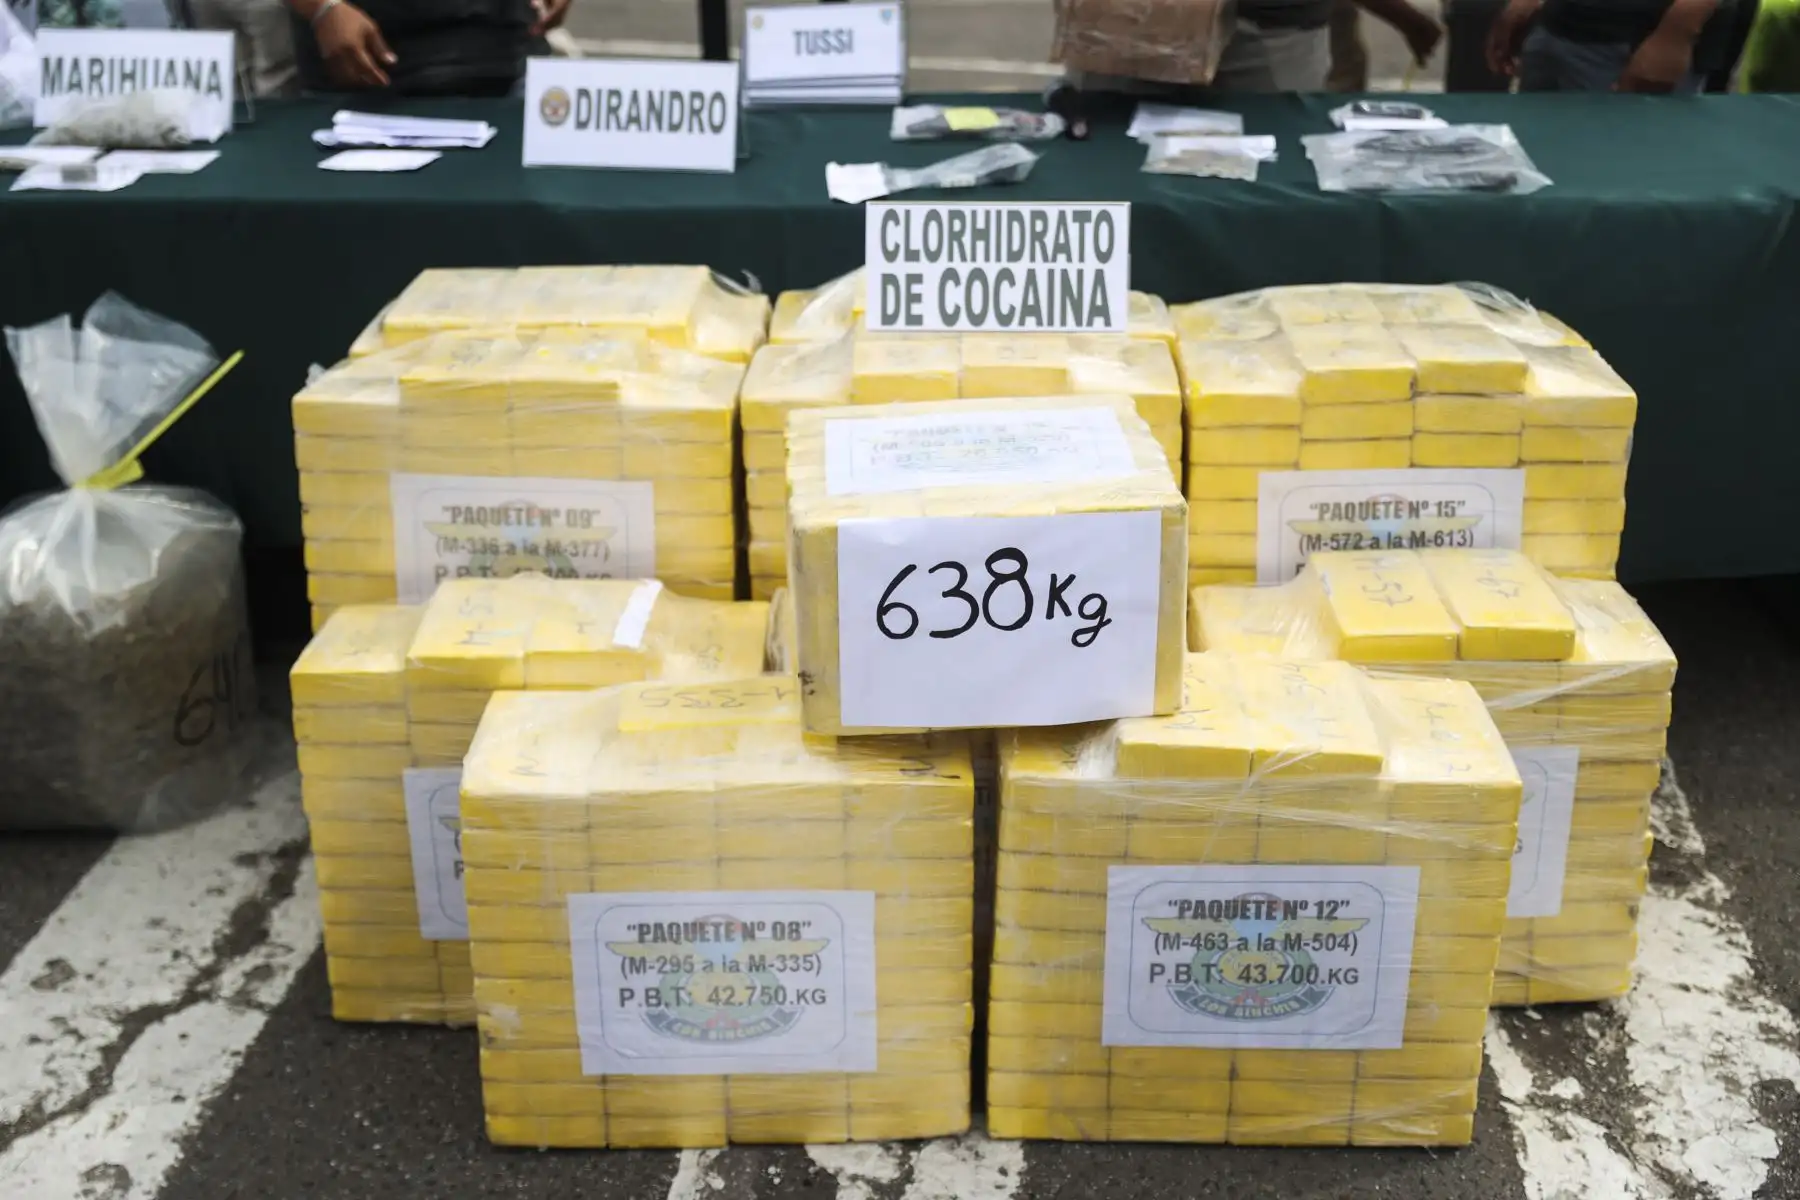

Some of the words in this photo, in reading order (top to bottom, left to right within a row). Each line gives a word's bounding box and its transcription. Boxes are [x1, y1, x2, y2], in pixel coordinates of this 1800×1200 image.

[793, 29, 854, 56] TUSSI
[40, 57, 223, 101] MARIHUANA
[574, 88, 726, 134] DIRANDRO
[880, 208, 1115, 264] CLORHIDRATO
[880, 272, 924, 327] DE
[938, 267, 1112, 327] COCAINA
[503, 542, 517, 556] a
[523, 538, 539, 556] la
[545, 539, 611, 561] M-377)
[1299, 532, 1363, 555] (M-572
[1369, 537, 1381, 549] a
[1387, 532, 1403, 549] la
[1409, 530, 1474, 551] M-613)
[876, 547, 1033, 640] 638
[1045, 573, 1112, 647] Kg
[1154, 932, 1228, 955] (M-463
[1236, 937, 1249, 951] a
[1256, 932, 1275, 951] la
[1283, 932, 1358, 956] M-504)
[620, 955, 695, 979] (M-295
[701, 960, 715, 972] a
[722, 956, 741, 973] la
[748, 953, 822, 977] M-335)
[1150, 963, 1223, 985] P.B.T:
